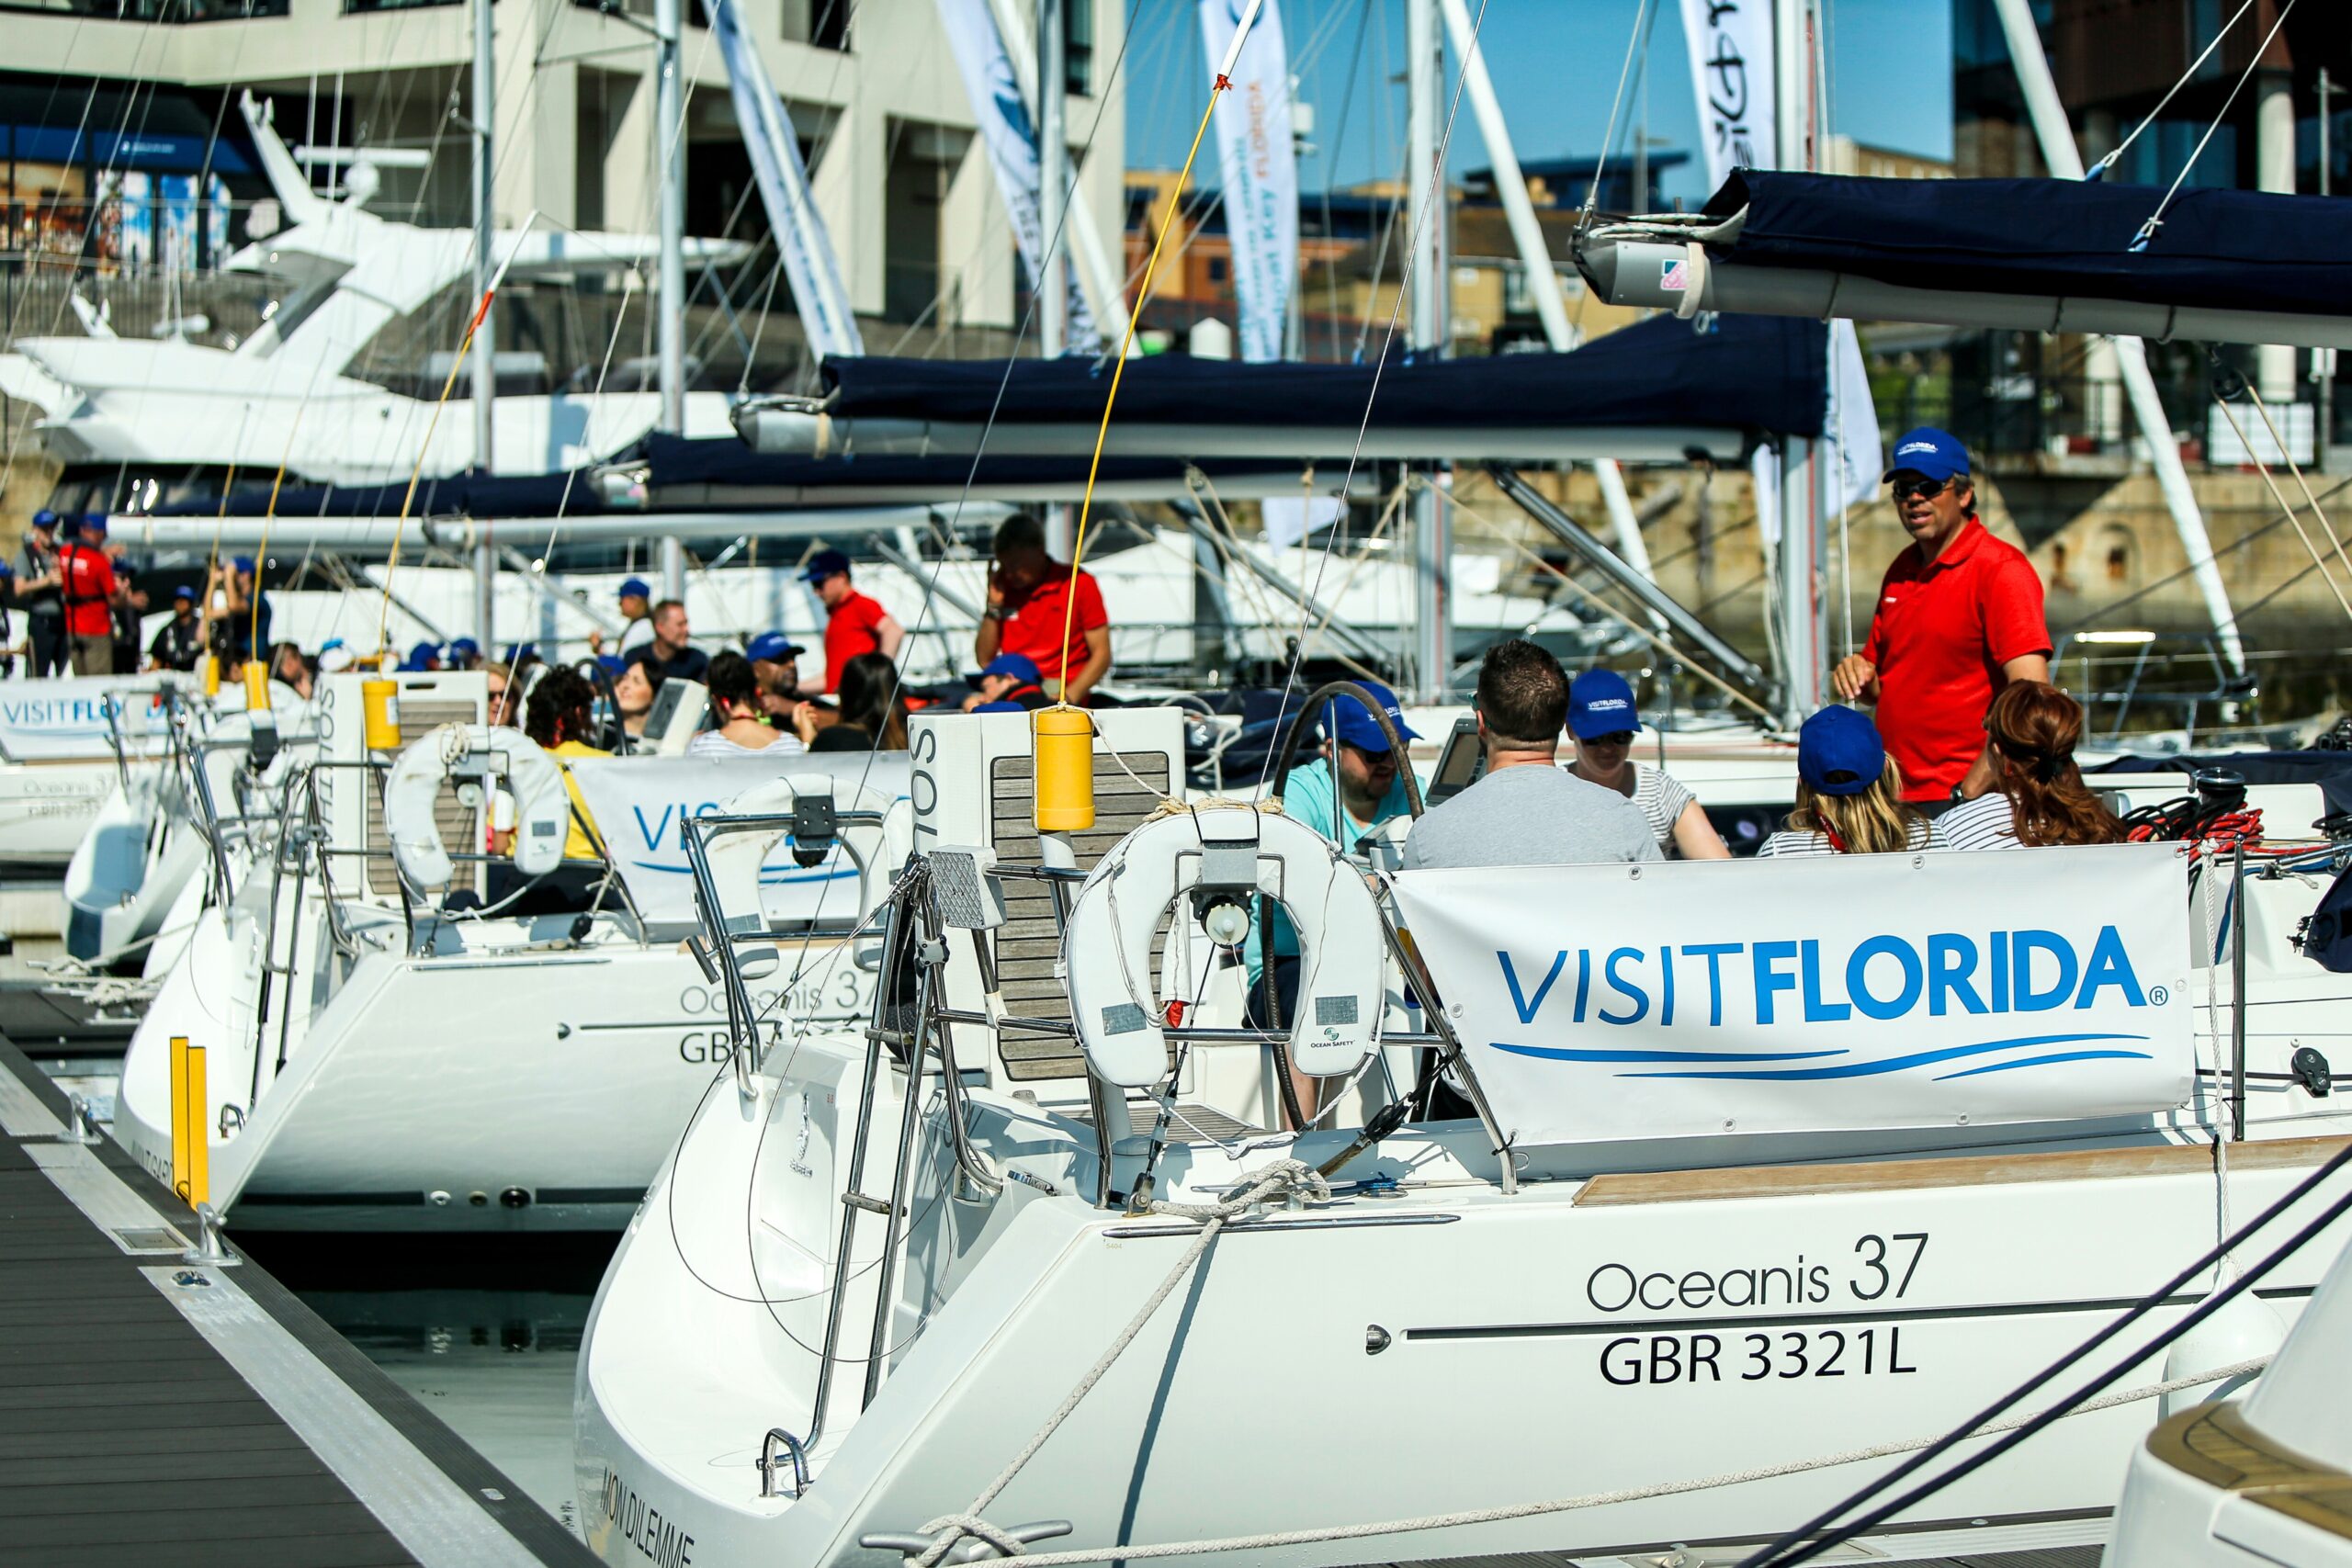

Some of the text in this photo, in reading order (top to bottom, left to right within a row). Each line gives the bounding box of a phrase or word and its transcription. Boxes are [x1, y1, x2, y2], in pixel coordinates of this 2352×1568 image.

[1247, 79, 1270, 178] FLORIDA
[1105, 1242, 1122, 1250] 5404
[1587, 1232, 1928, 1312] Oceanis 37
[1600, 1326, 1917, 1385] GBR 3321L
[599, 1466, 695, 1568] MON DILEMME
